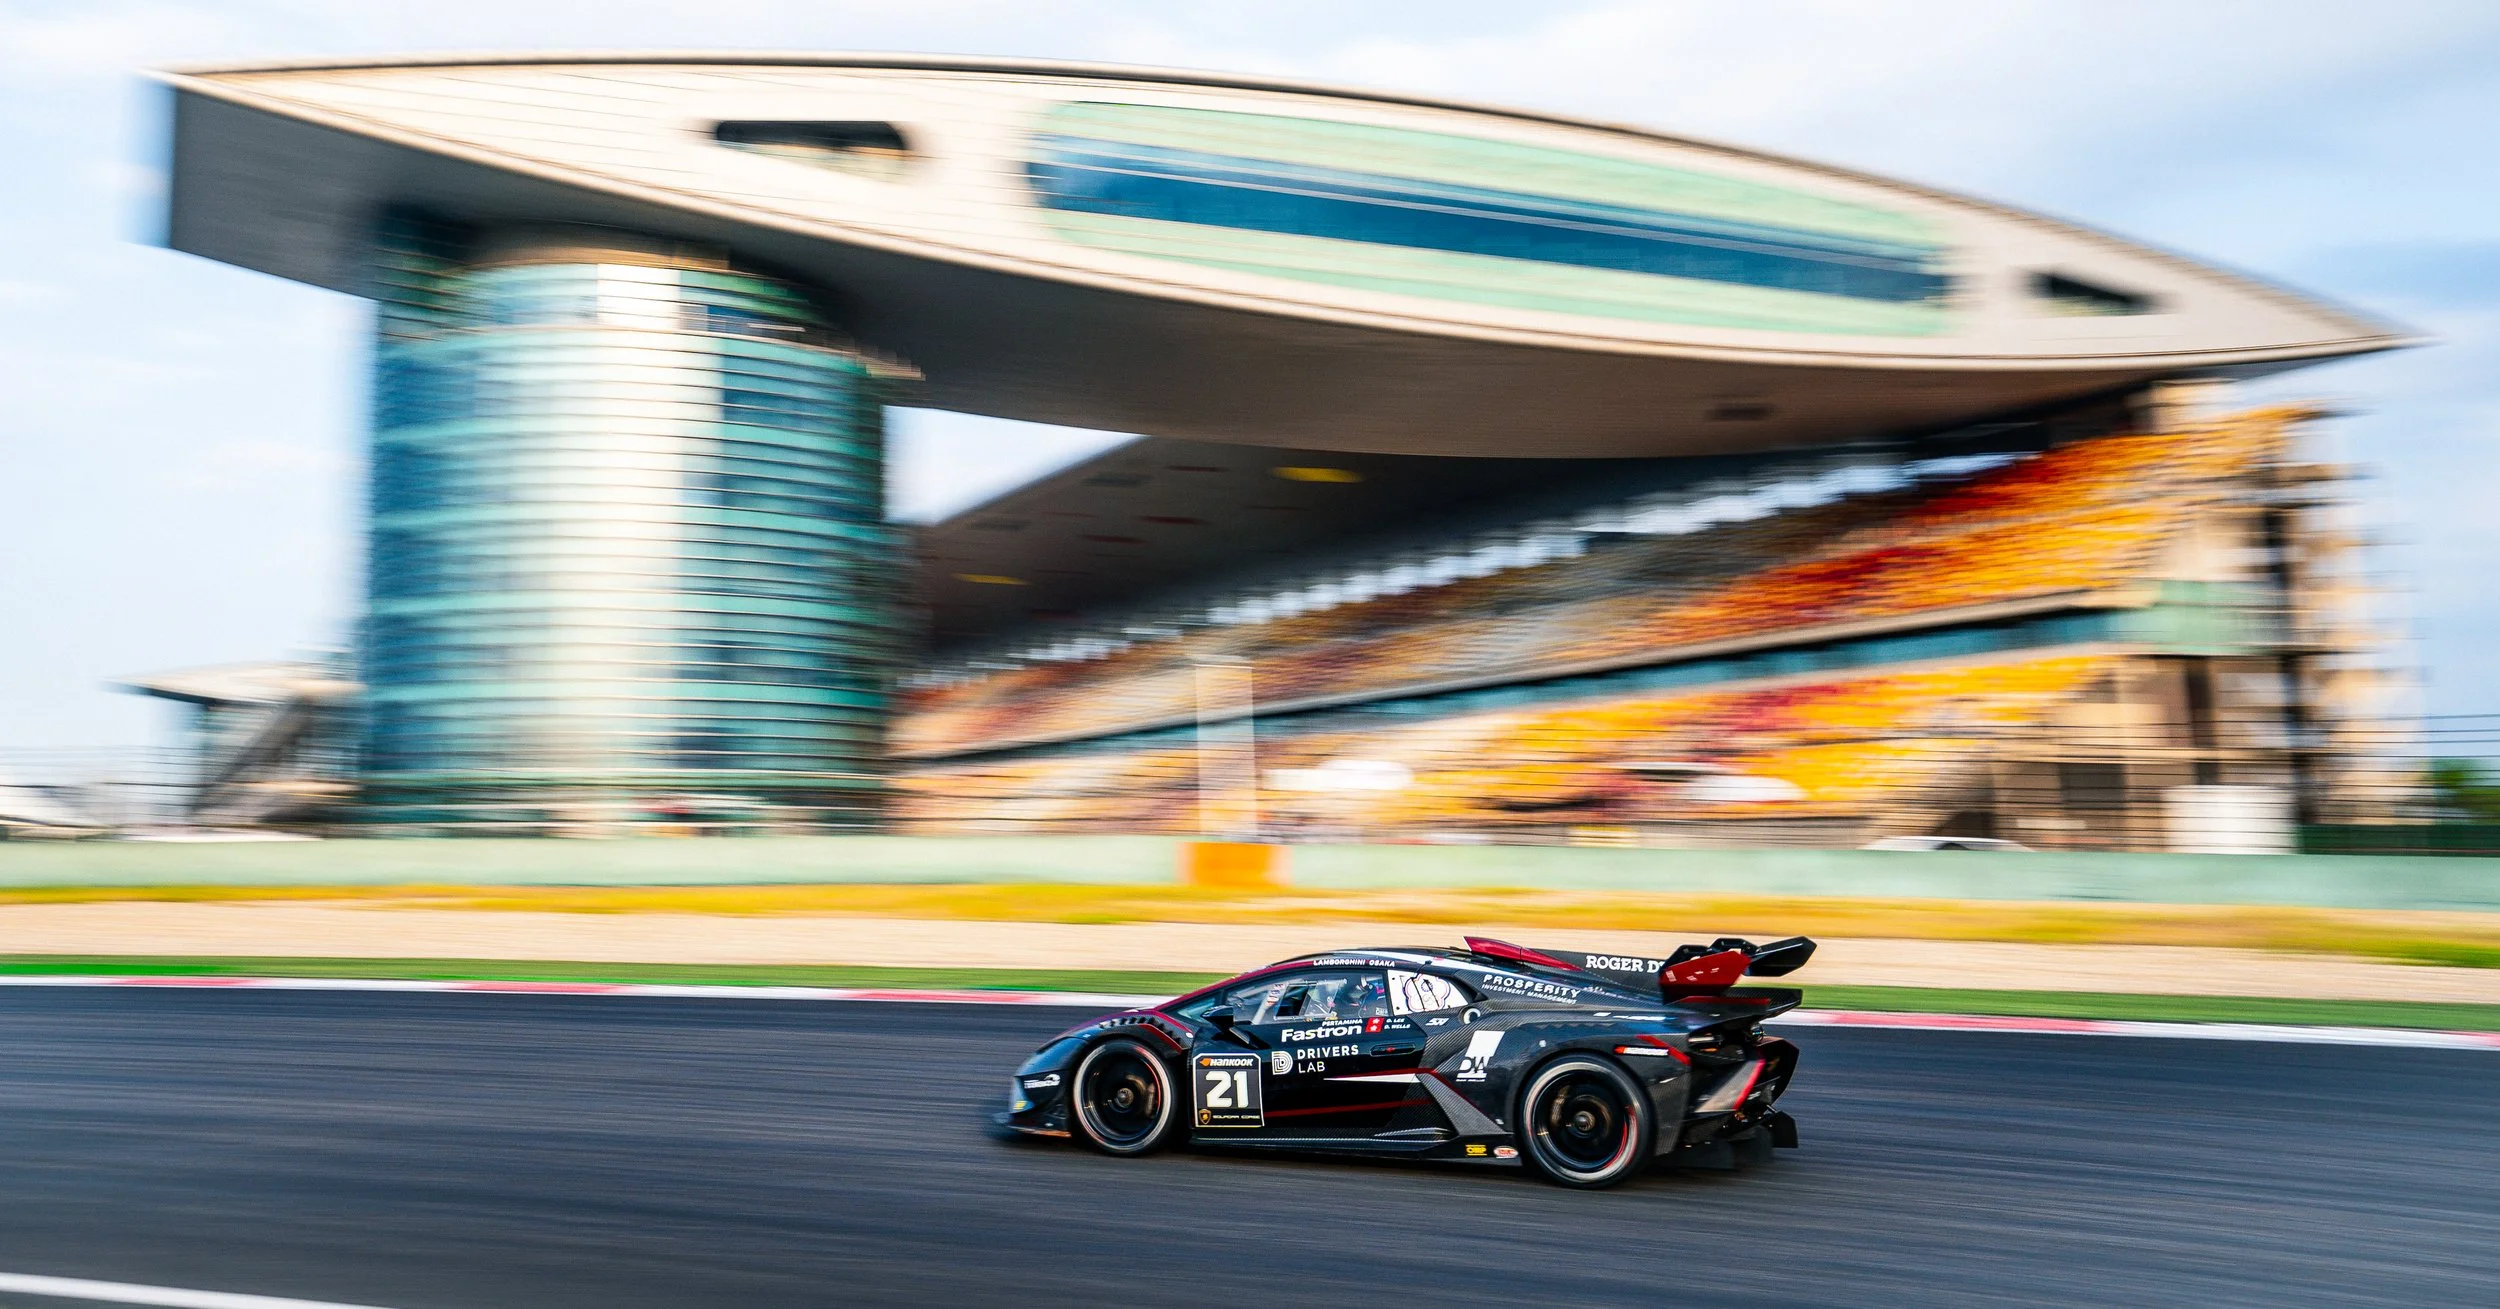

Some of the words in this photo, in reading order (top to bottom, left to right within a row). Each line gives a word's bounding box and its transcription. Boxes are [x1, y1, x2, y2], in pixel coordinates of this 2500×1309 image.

[1585, 955, 1644, 973] ROGER
[1481, 983, 1526, 996] INVESTMENT
[1526, 990, 1578, 1005] MANAGEMENT
[1483, 974, 1581, 999] PROSPERITY
[1322, 1018, 1363, 1027] PERTAMINA
[1281, 1025, 1362, 1043] Fastron
[1297, 1044, 1359, 1060] DRIVERS
[1298, 1061, 1326, 1074] LAB
[1205, 1070, 1249, 1108] 21
